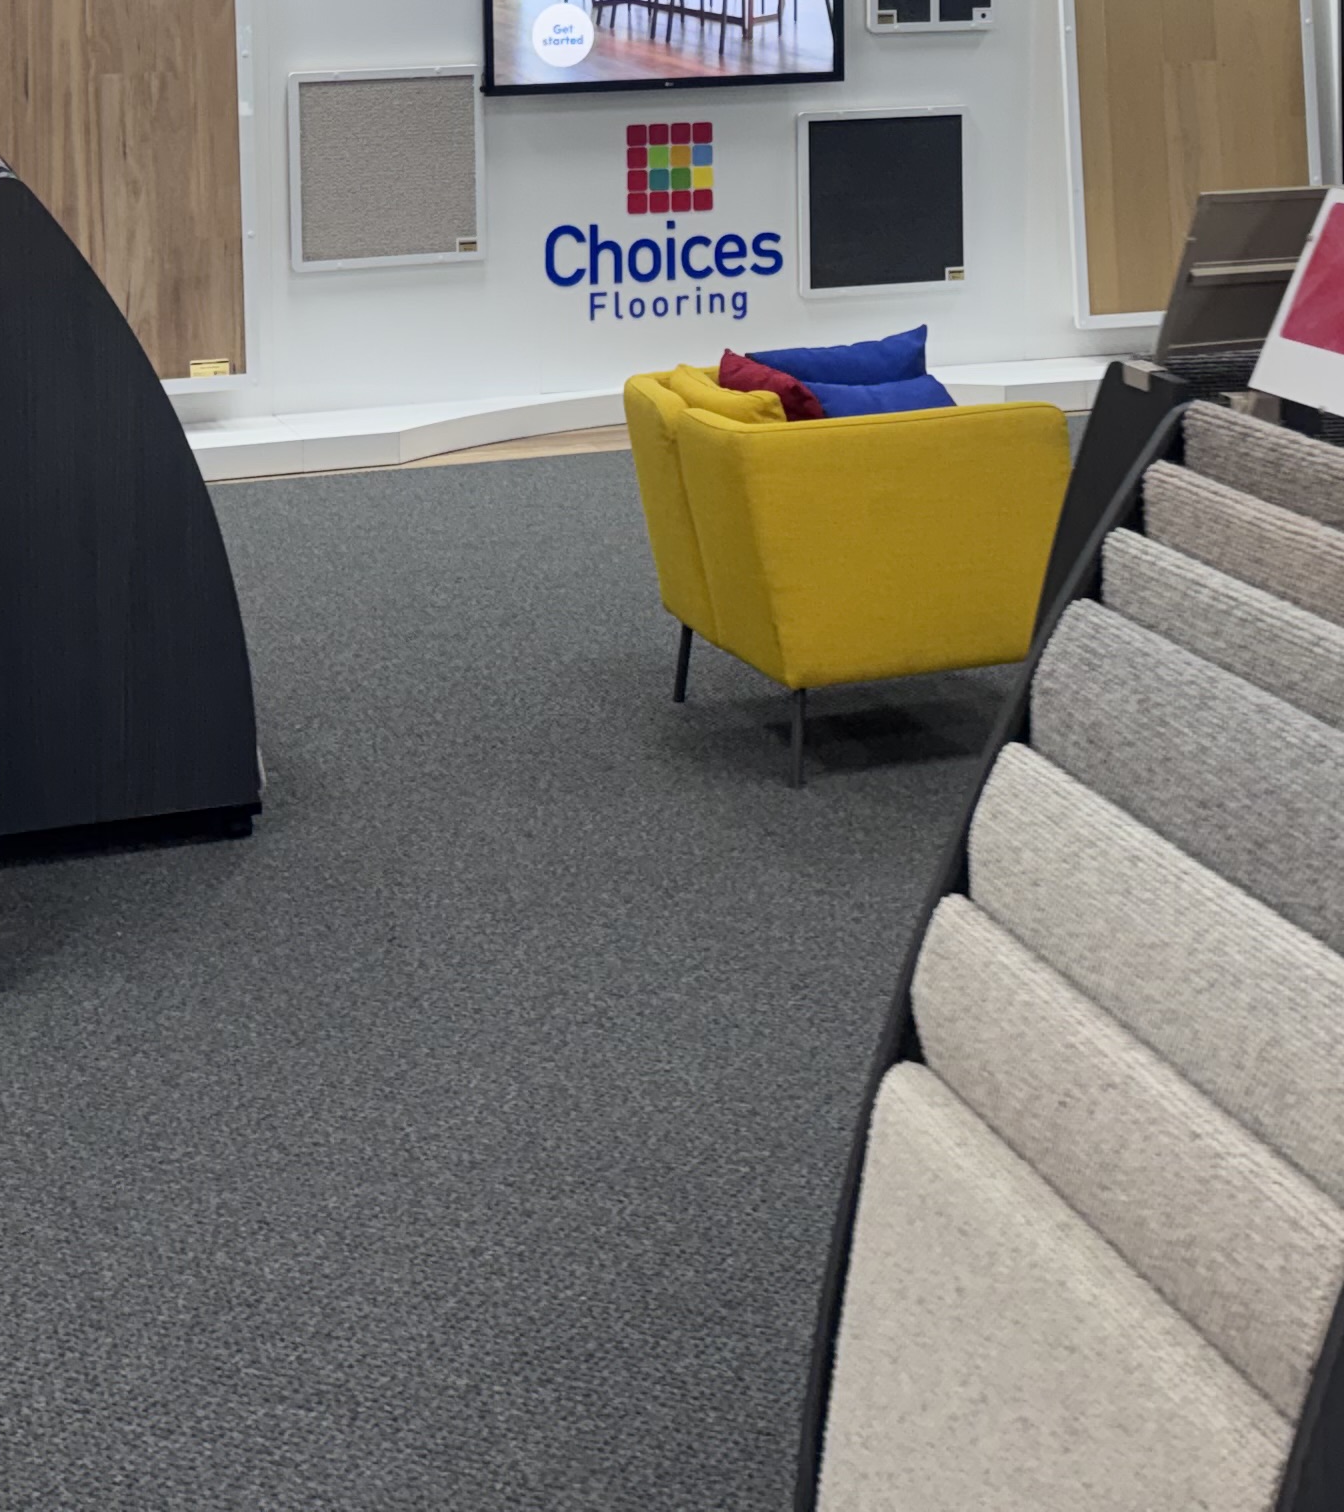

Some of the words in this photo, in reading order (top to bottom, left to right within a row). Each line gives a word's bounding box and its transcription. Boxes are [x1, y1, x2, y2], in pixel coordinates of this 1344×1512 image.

[542, 35, 585, 46] started
[552, 24, 574, 35] Get
[544, 220, 784, 287] Choices
[589, 286, 748, 322] Flooring
